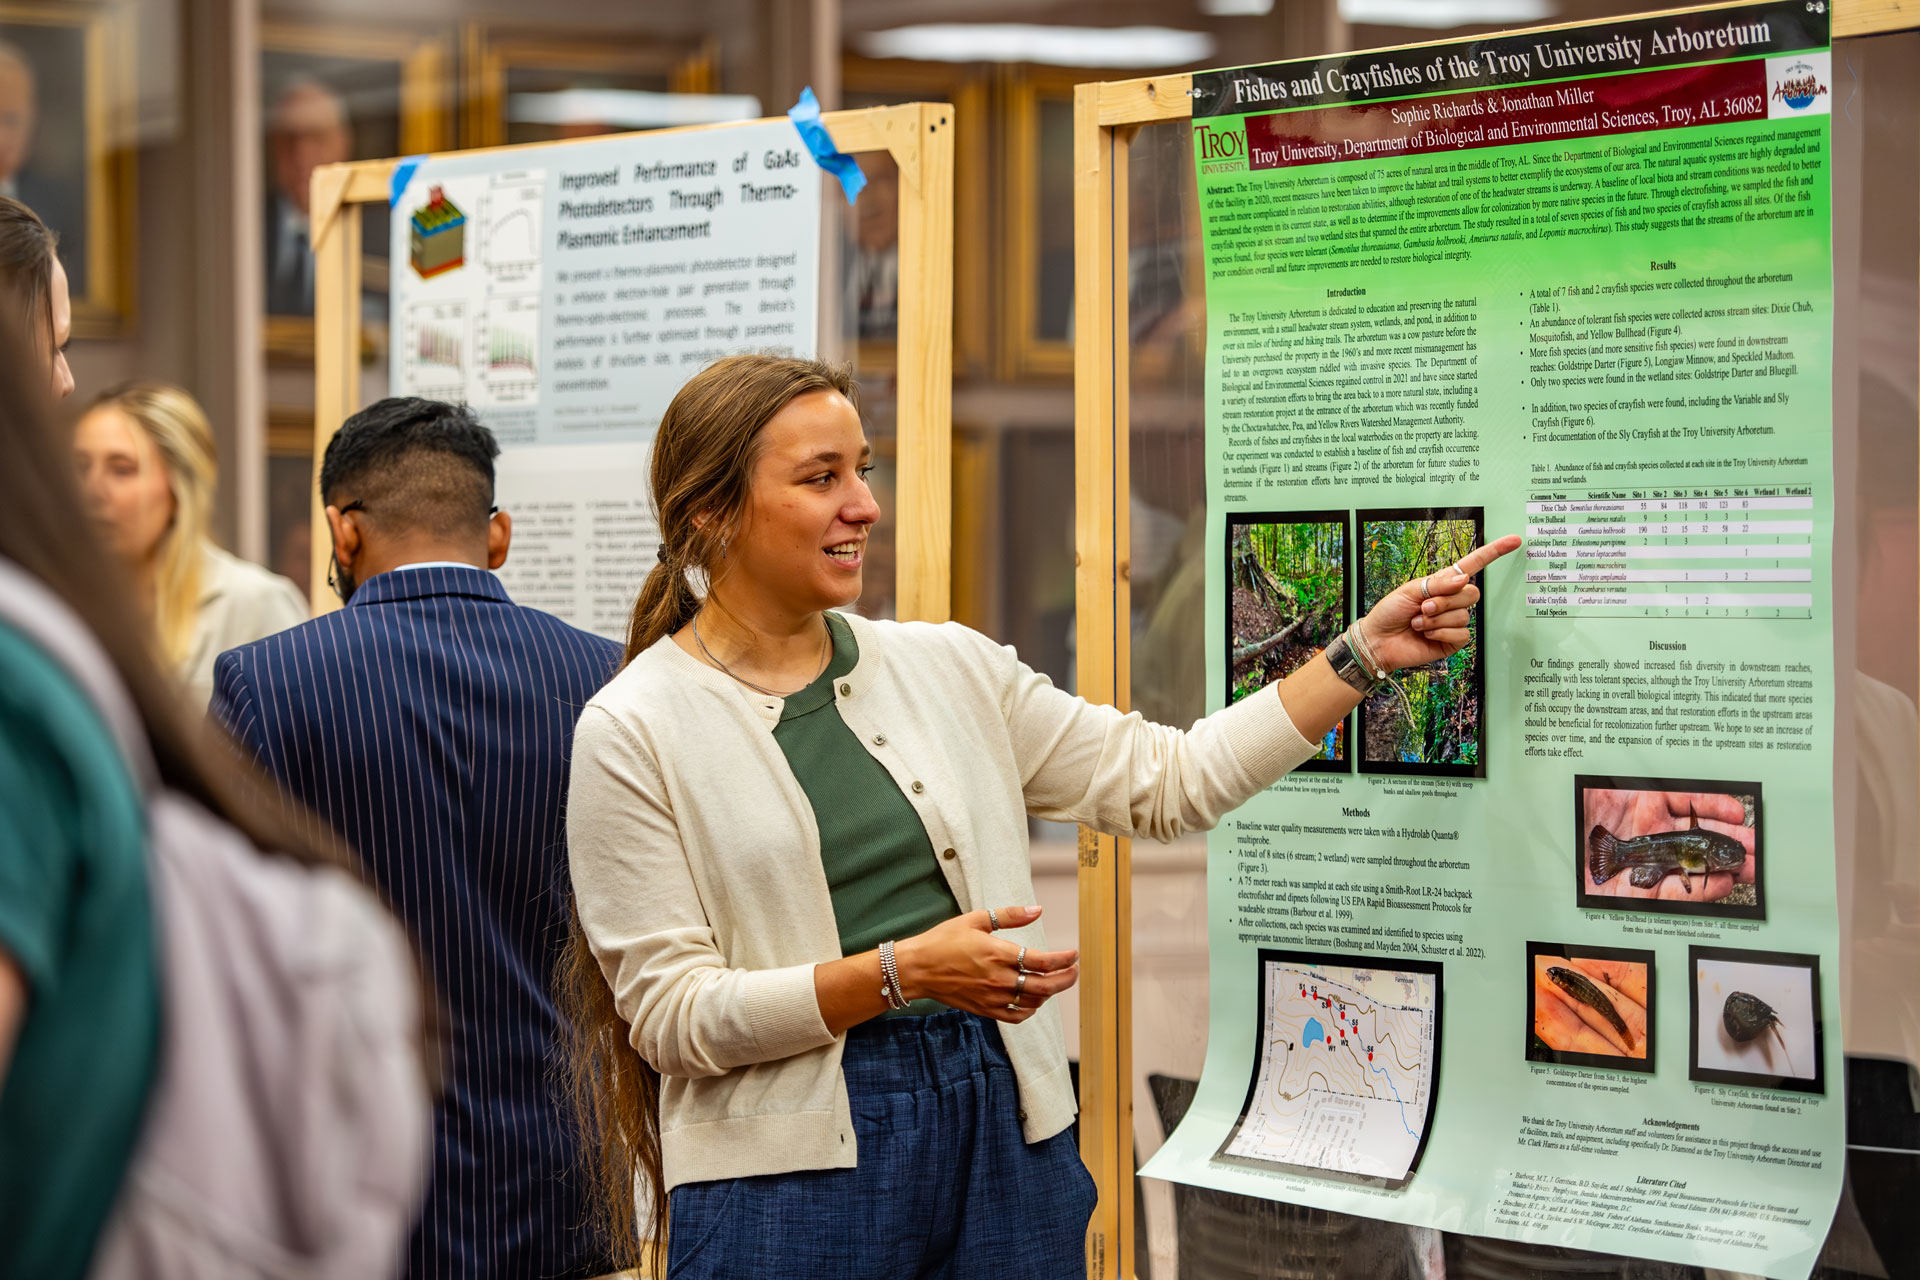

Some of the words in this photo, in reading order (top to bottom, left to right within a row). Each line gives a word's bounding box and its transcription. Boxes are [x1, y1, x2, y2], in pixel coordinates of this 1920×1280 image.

[1234, 78, 1287, 104] Fishes
[1291, 70, 1324, 96] and
[1326, 62, 1422, 96] Crayfishes
[1426, 56, 1445, 81] of
[1448, 54, 1480, 78] the
[1481, 50, 1531, 78] Troy
[1534, 34, 1642, 68] University
[1651, 22, 1770, 56] Arboretum
[1772, 80, 1828, 102] Arboretum
[1391, 105, 1430, 126] Sophie
[1432, 98, 1484, 119] Richards
[1487, 97, 1498, 113] &
[1501, 92, 1554, 112] Jonathan
[1556, 87, 1594, 105] Miller
[1252, 147, 1278, 166] Troy
[1280, 142, 1342, 169] University,
[1342, 130, 1408, 157] Department
[1410, 130, 1423, 147] of
[1424, 124, 1484, 147] Biological
[1487, 121, 1508, 140] and
[1510, 112, 1598, 137] Environmental
[1601, 111, 1658, 128] Sciences,
[1661, 104, 1695, 124] Troy,
[1699, 100, 1719, 118] AL
[1724, 94, 1762, 116] 36082
[1194, 125, 1245, 159] TROY
[560, 167, 620, 191] Improved
[633, 160, 717, 182] Performance
[732, 151, 749, 174] of
[762, 148, 800, 171] GaAs
[558, 196, 653, 219] Photodetectors
[668, 187, 723, 211] Through
[740, 182, 798, 202] Thermo-
[556, 230, 619, 250] Plasmonic
[621, 220, 710, 245] Enhancement
[1212, 270, 1226, 279] poor
[1226, 266, 1253, 276] condition
[1254, 264, 1274, 274] overall
[1276, 262, 1286, 272] and
[1288, 262, 1305, 272] future
[1306, 260, 1348, 272] improvements
[1360, 255, 1381, 266] needed
[1390, 255, 1411, 264] restore
[1412, 250, 1442, 263] biological
[1650, 259, 1676, 271] Results
[1326, 286, 1366, 297] Introduction
[1529, 289, 1535, 298] A
[1536, 287, 1551, 298] total
[1552, 286, 1560, 297] of
[1561, 286, 1566, 296] 7
[1567, 285, 1580, 295] fish
[1581, 284, 1593, 294] and
[1595, 284, 1599, 294] 2
[1601, 282, 1628, 295] crayfish
[1629, 283, 1654, 294] species
[1673, 276, 1704, 288] collected
[1705, 275, 1743, 288] throughout
[1744, 273, 1755, 284] the
[1757, 272, 1792, 283] arboretum
[1529, 302, 1550, 315] (Table
[1552, 302, 1561, 313] 1).
[1529, 330, 1574, 344] Mosquitofish,
[1576, 329, 1588, 340] and
[1590, 328, 1613, 339] Yellow
[1615, 326, 1645, 338] Bullhead
[1647, 326, 1671, 338] (Figure
[1673, 325, 1682, 336] 4).
[1222, 424, 1229, 435] by
[1231, 423, 1240, 432] the
[1241, 421, 1290, 432] Choctawhatchee,
[1292, 420, 1304, 430] Pea,
[1306, 420, 1317, 429] and
[1317, 419, 1338, 429] Yellow
[1340, 418, 1359, 428] Rivers
[1360, 416, 1392, 427] Watershed
[1392, 416, 1432, 428] Management
[1433, 414, 1465, 425] Authority.
[1531, 416, 1559, 429] Crayfish
[1560, 416, 1584, 428] (Figure
[1586, 415, 1594, 426] 6).
[1532, 432, 1547, 442] First
[1548, 431, 1596, 441] documentation
[1597, 429, 1606, 440] of
[1606, 429, 1617, 439] the
[1618, 428, 1630, 441] Sly
[1631, 428, 1660, 440] Crayfish
[1662, 429, 1668, 437] at
[1670, 427, 1680, 437] the
[1682, 426, 1698, 439] Troy
[1699, 426, 1735, 438] University
[1736, 424, 1774, 435] Arboretum.
[1649, 640, 1686, 650] Discussion
[1536, 687, 1549, 697] still
[1550, 688, 1574, 700] greatly
[1575, 688, 1600, 701] lacking
[1611, 689, 1635, 699] overall
[1636, 689, 1670, 702] biological
[1672, 692, 1702, 703] integrity.
[1704, 690, 1719, 701] This
[1721, 691, 1751, 702] indicated
[1753, 692, 1766, 702] that
[1788, 695, 1812, 706] species
[1524, 745, 1546, 756] efforts
[1547, 746, 1561, 756] take
[1562, 747, 1584, 757] effect.
[1342, 807, 1370, 817] Methods
[1236, 834, 1272, 846] multiprobe.
[1237, 861, 1259, 874] (Figure
[1260, 863, 1269, 873] 3).
[1238, 903, 1265, 913] wadeable
[1266, 906, 1289, 915] streams
[1290, 906, 1317, 917] (Barbour
[1325, 908, 1334, 918] al.
[1335, 909, 1354, 921] 1999).
[1642, 1117, 1699, 1130] Acknowledgements
[1527, 1138, 1541, 1147] Clark
[1542, 1140, 1558, 1148] Harris
[1570, 1143, 1593, 1153] full-time
[1636, 1175, 1668, 1186] Literature
[1668, 1179, 1686, 1189] Cited
